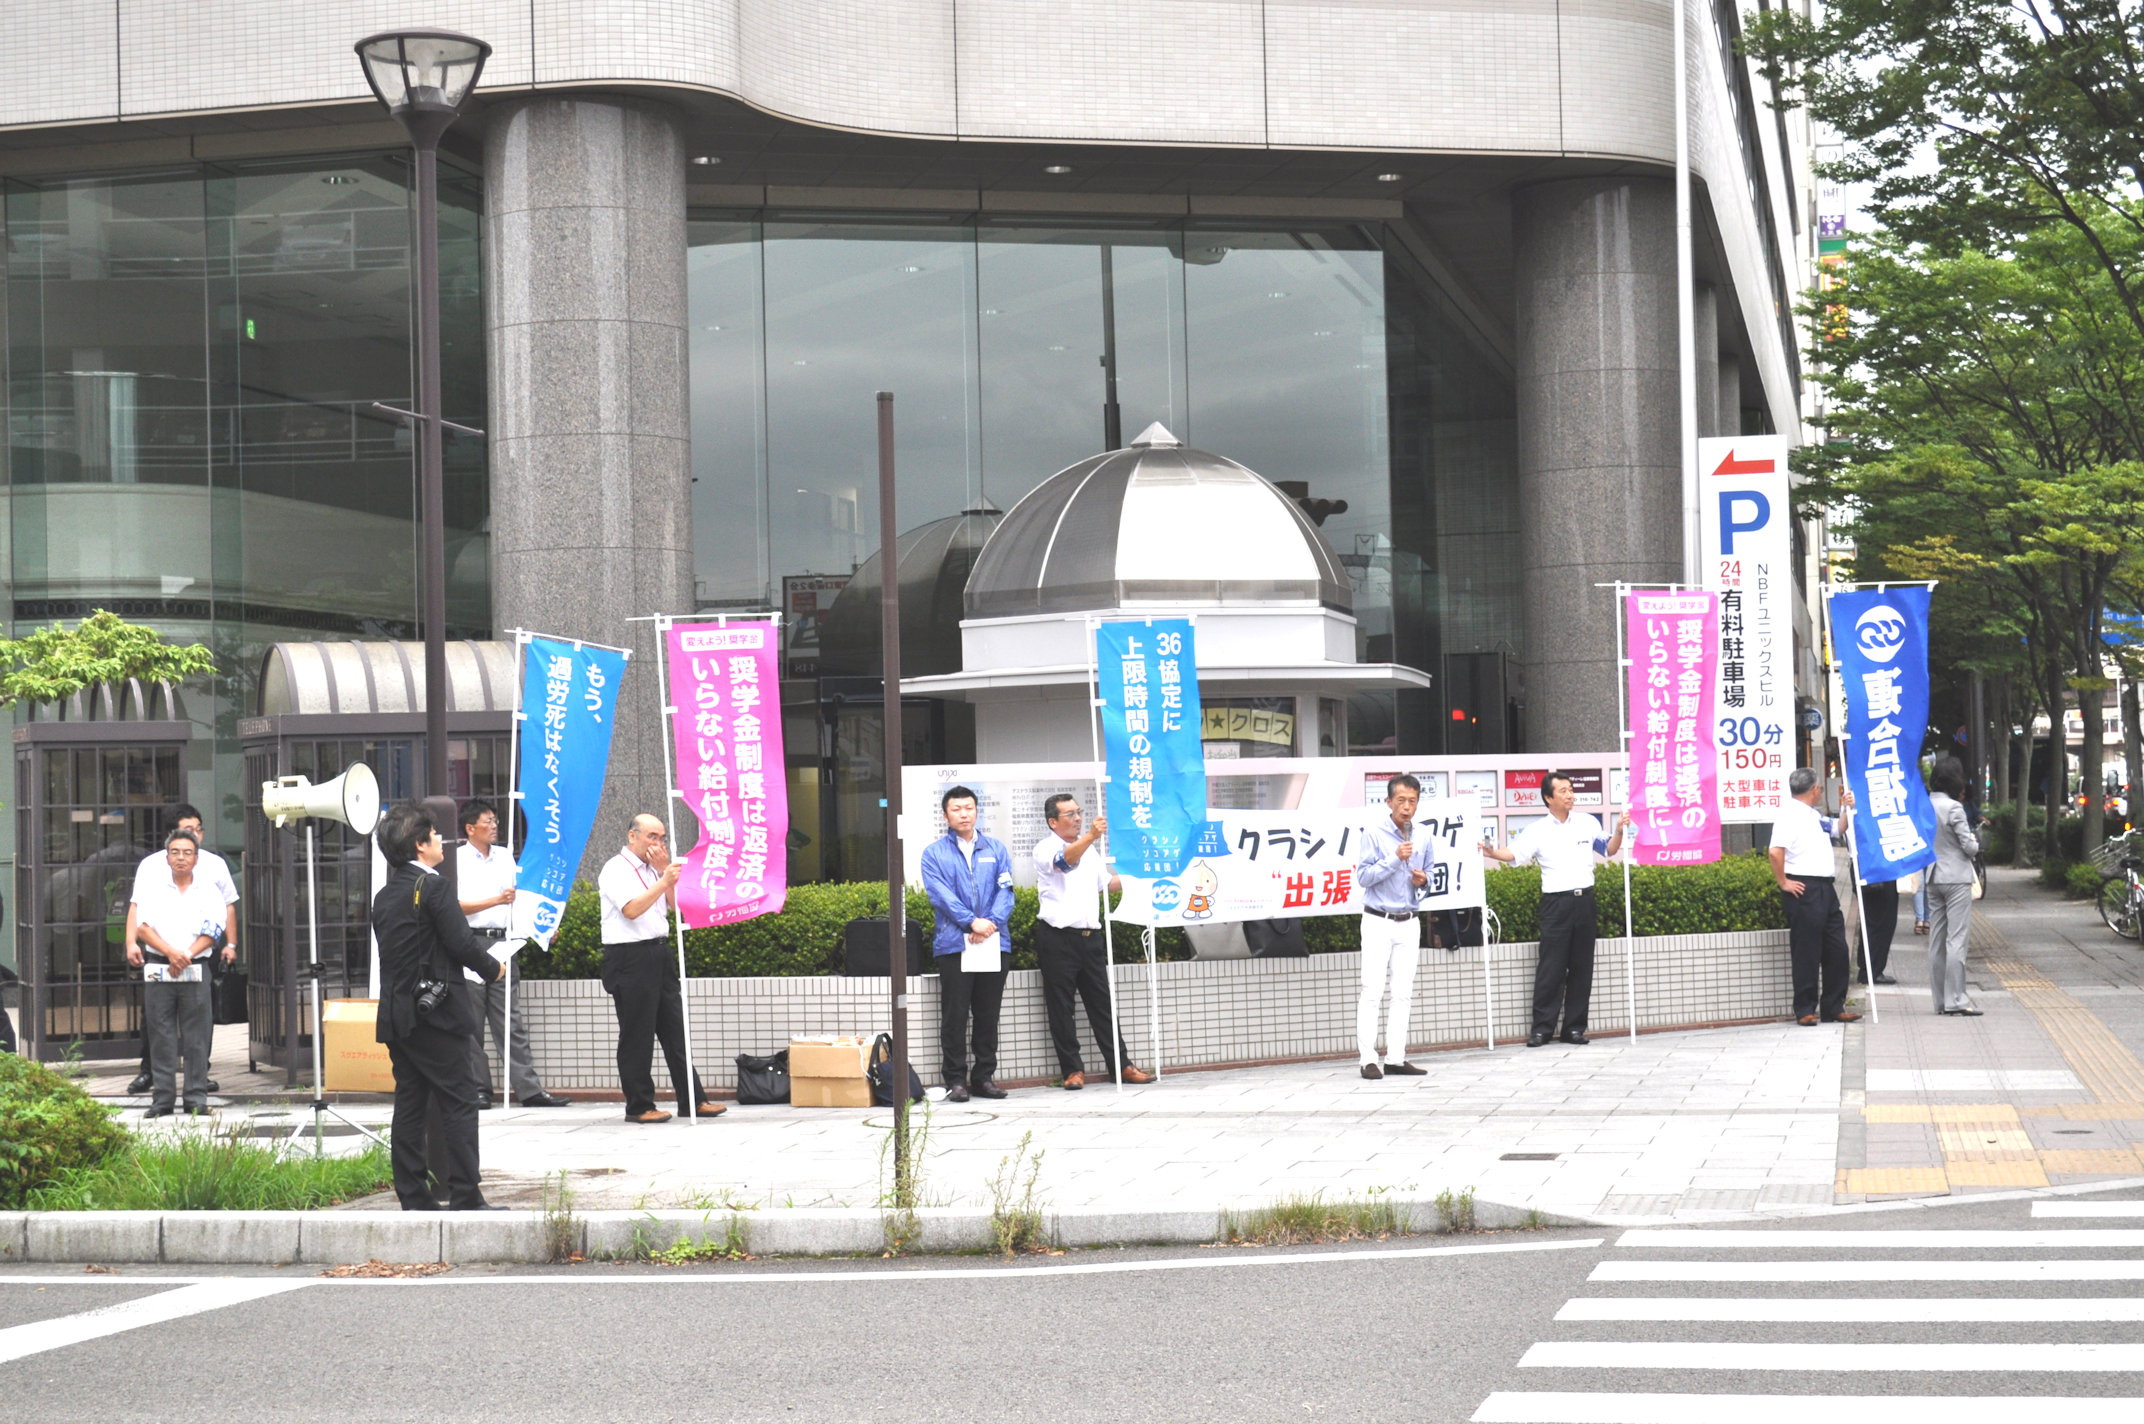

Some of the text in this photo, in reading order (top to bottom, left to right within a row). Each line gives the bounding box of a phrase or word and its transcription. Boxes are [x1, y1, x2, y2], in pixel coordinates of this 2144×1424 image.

[1719, 489, 1771, 556] P
[1720, 561, 1742, 578] 24
[1721, 589, 1745, 708] 有料駐車場
[1757, 563, 1774, 707] NBFユニックスビル
[584, 663, 605, 724] もう、
[1121, 636, 1154, 829] 上限時間の規制を
[1645, 619, 1673, 847] いらない給付制度に!
[1675, 619, 1707, 828] 奨学金制度は返済の
[1718, 716, 1784, 747] 30分
[691, 657, 736, 909] いらない給付制度に!
[728, 656, 768, 899] 奨学金制度は返済の
[1721, 748, 1782, 769] 150円
[1723, 779, 1781, 792] 大型車は
[1723, 795, 1781, 809] 駐車不可
